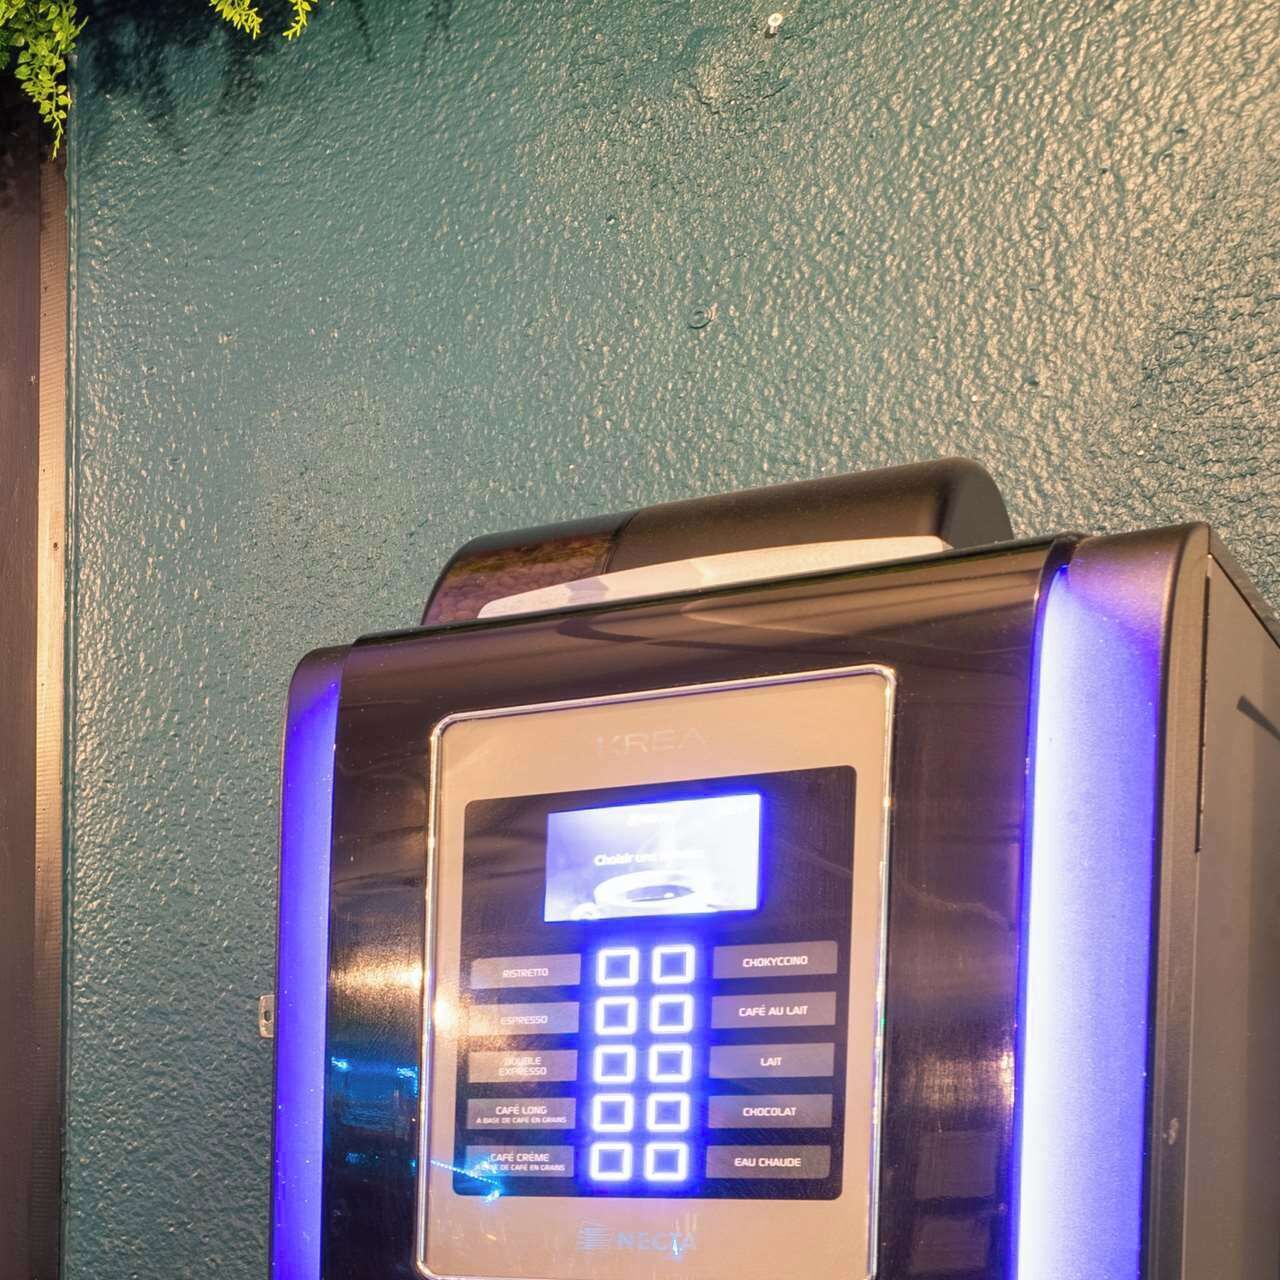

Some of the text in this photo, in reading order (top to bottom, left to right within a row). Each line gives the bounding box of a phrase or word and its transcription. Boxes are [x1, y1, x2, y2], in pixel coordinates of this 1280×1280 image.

[593, 851, 634, 867] Choisir
[742, 956, 809, 968] CHOKYCCINO
[502, 967, 549, 979] RISTRETTO
[738, 1004, 808, 1017] CAFÉ AU LAIT
[500, 1014, 549, 1026] ESPRESSO
[760, 1057, 782, 1067] LAIT
[495, 1104, 548, 1115] CAFÉ LONG
[742, 1106, 797, 1118] CHOCOLAT
[512, 1115, 530, 1124] CAFÉ
[490, 1150, 514, 1162] CAFÉ
[734, 1156, 801, 1168] EAU CHAUDE
[616, 1231, 697, 1251] NECTA
